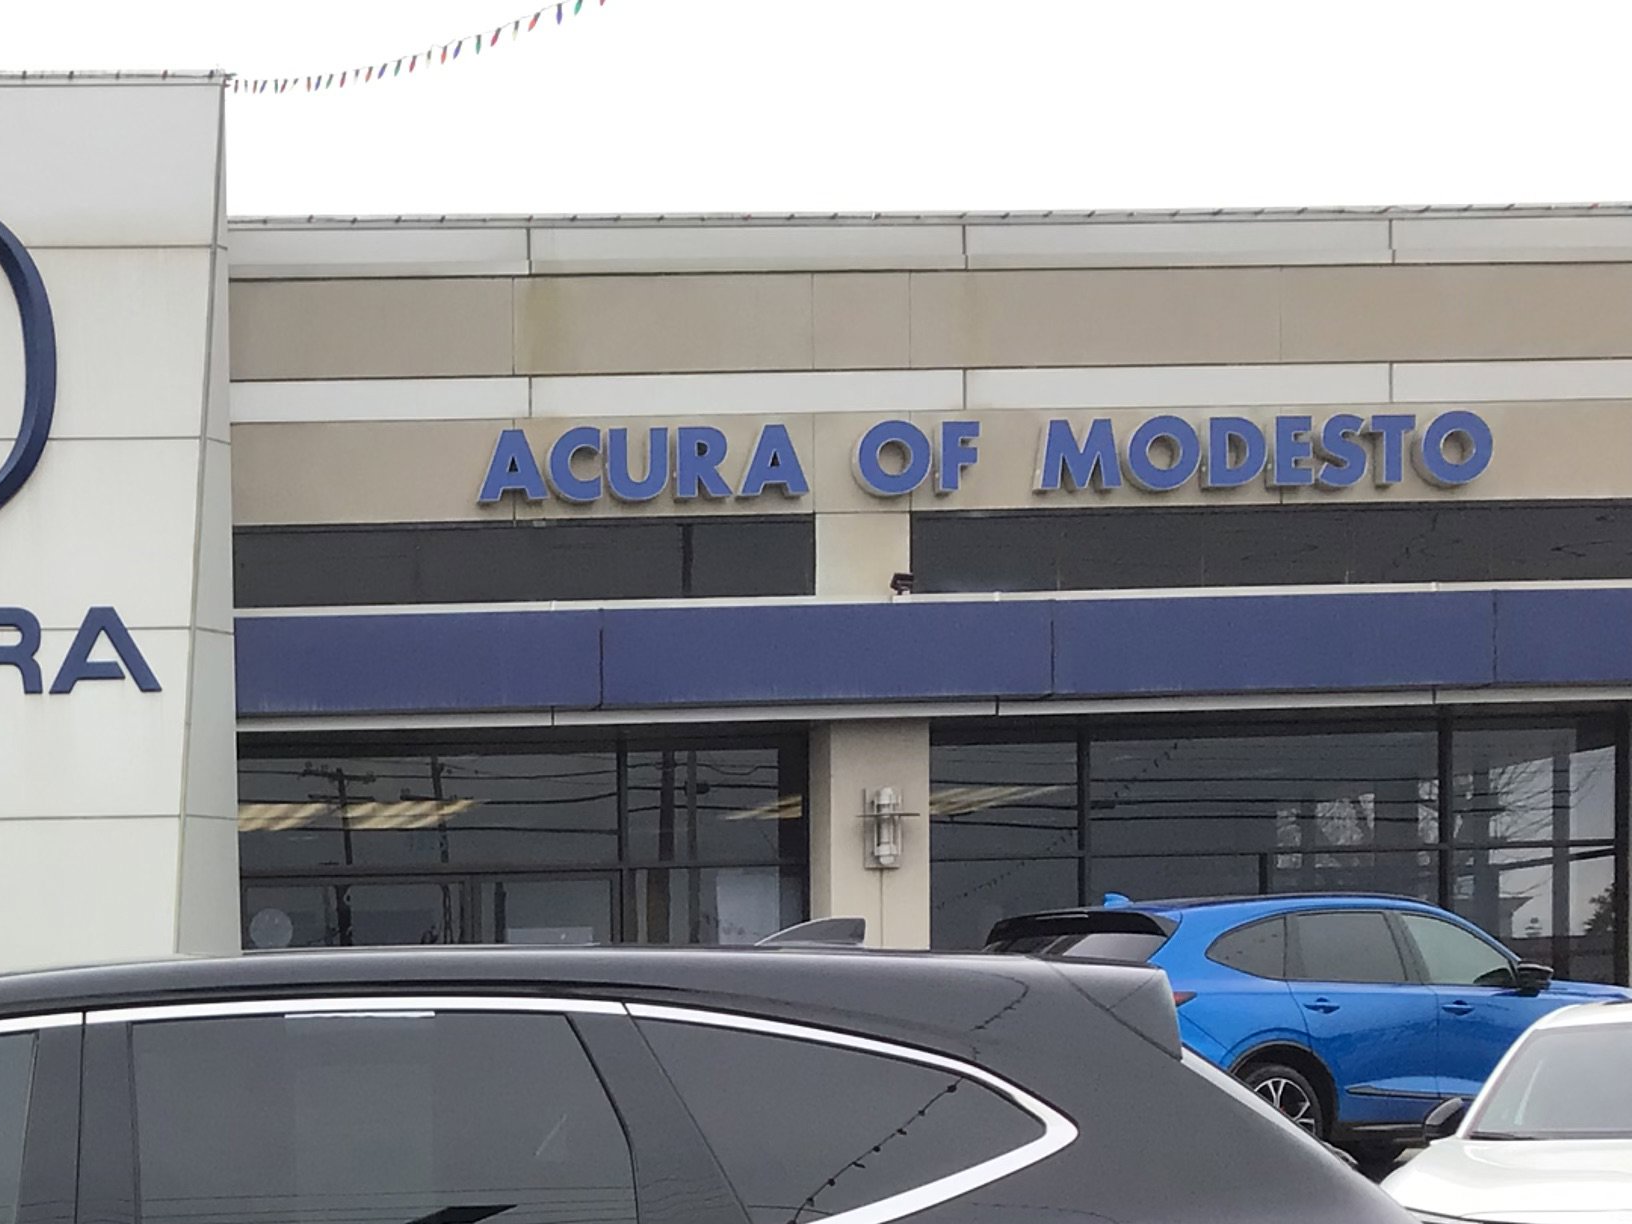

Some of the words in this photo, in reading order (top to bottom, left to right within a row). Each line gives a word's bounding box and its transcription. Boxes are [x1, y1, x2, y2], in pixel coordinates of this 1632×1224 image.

[478, 423, 811, 503] ACURA
[854, 419, 981, 497] OF
[1034, 410, 1494, 493] MODESTO
